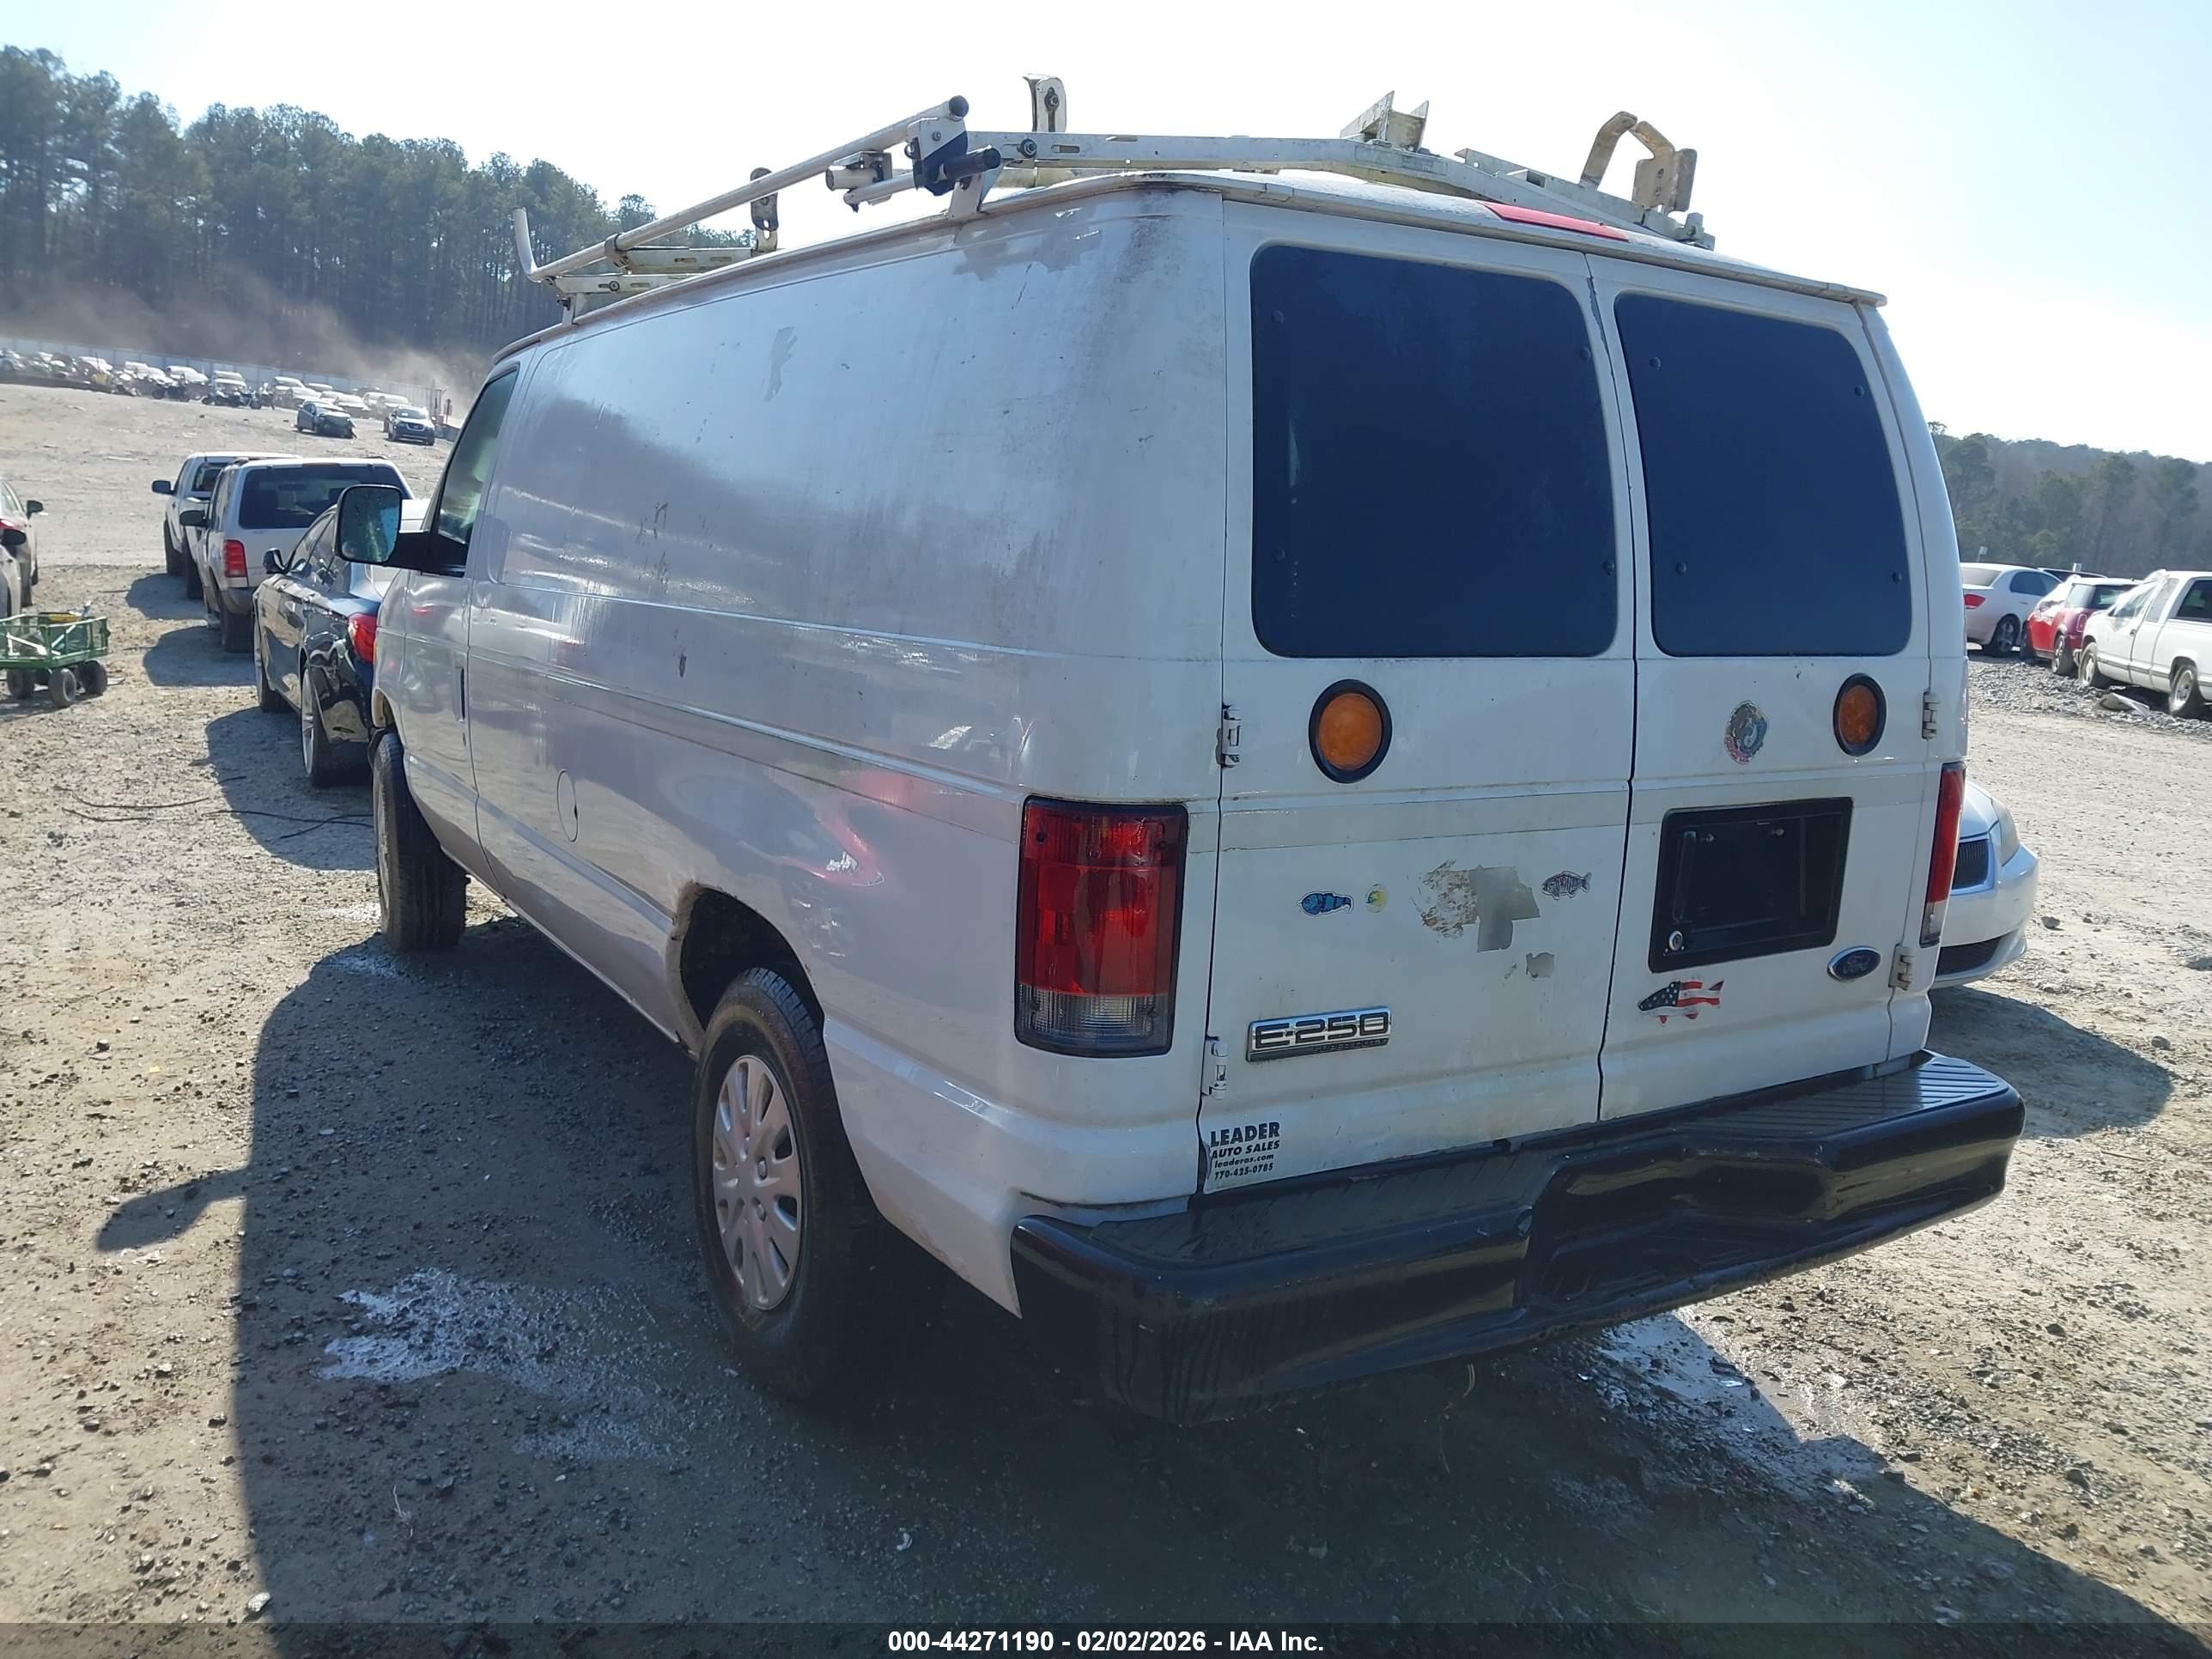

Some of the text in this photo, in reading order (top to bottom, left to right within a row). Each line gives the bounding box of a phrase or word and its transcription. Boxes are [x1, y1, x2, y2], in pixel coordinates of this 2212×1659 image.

[1255, 1012, 1389, 1049] E-250
[1210, 1121, 1280, 1147] LEADER
[1212, 1139, 1280, 1159] AUTO SALES
[1214, 1153, 1274, 1169] leaderas.com
